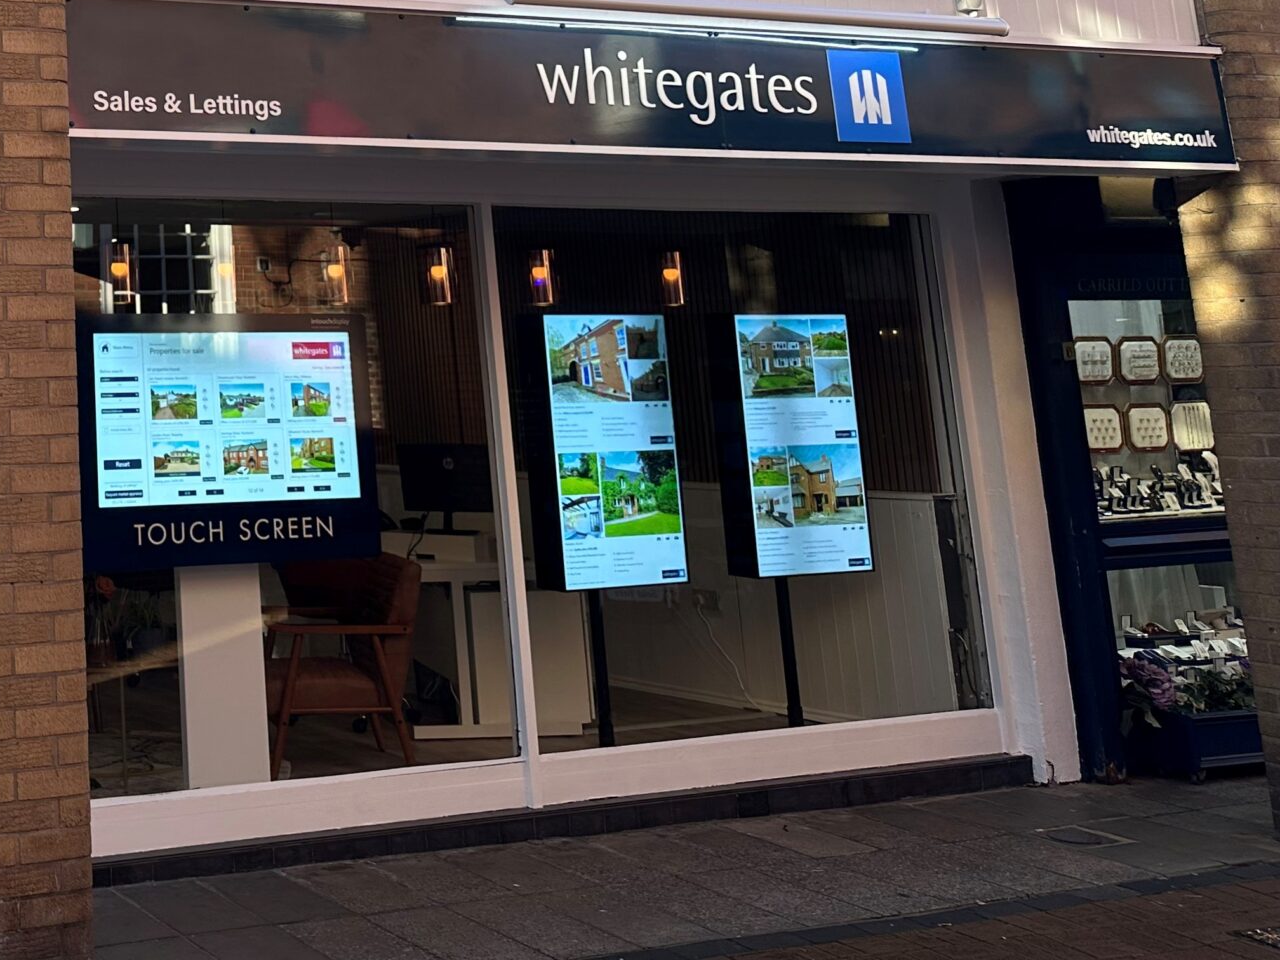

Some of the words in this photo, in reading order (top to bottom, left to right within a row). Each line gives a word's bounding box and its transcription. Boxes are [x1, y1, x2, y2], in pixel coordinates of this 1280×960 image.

[536, 47, 818, 126] whitegates
[93, 90, 158, 113] Sales
[163, 92, 182, 113] &
[189, 93, 282, 121] Lettings
[1086, 125, 1218, 149] whitegates.co.uk
[149, 347, 181, 356] Properties
[293, 344, 329, 357] whitegates
[115, 460, 131, 468] Reset
[133, 520, 224, 546] TOUCH
[239, 516, 334, 542] SCREEN
